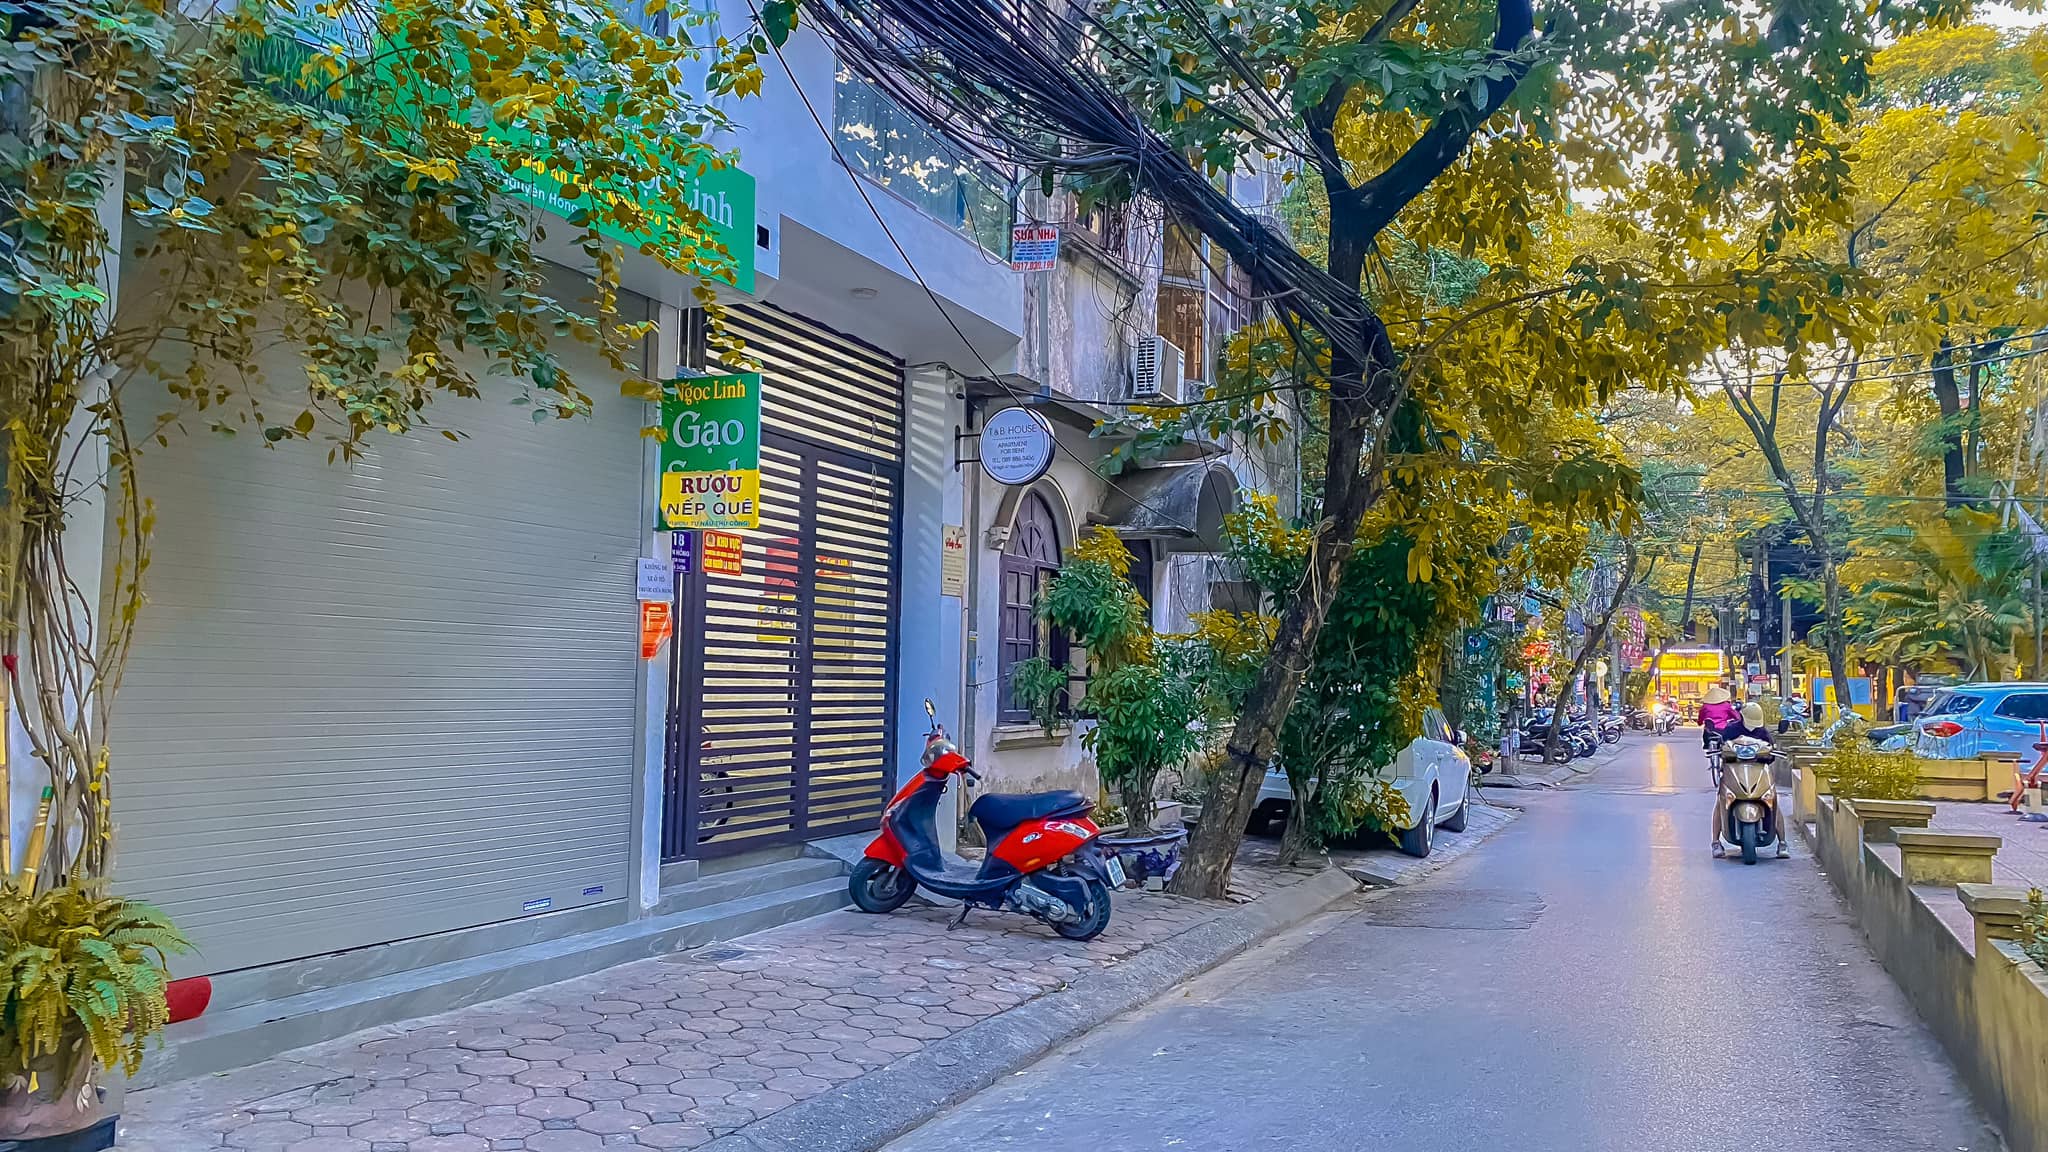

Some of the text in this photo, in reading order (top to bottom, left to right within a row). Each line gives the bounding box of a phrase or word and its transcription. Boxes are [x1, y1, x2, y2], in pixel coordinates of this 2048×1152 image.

[674, 379, 746, 405] Ngọc Linh
[673, 410, 744, 454] Gạo
[1008, 424, 1037, 434] HOUSE
[680, 474, 742, 497] RƯỢU
[666, 497, 753, 516] NẾP QUÊ
[673, 533, 685, 547] 18
[716, 536, 741, 551] KHU VỰC
